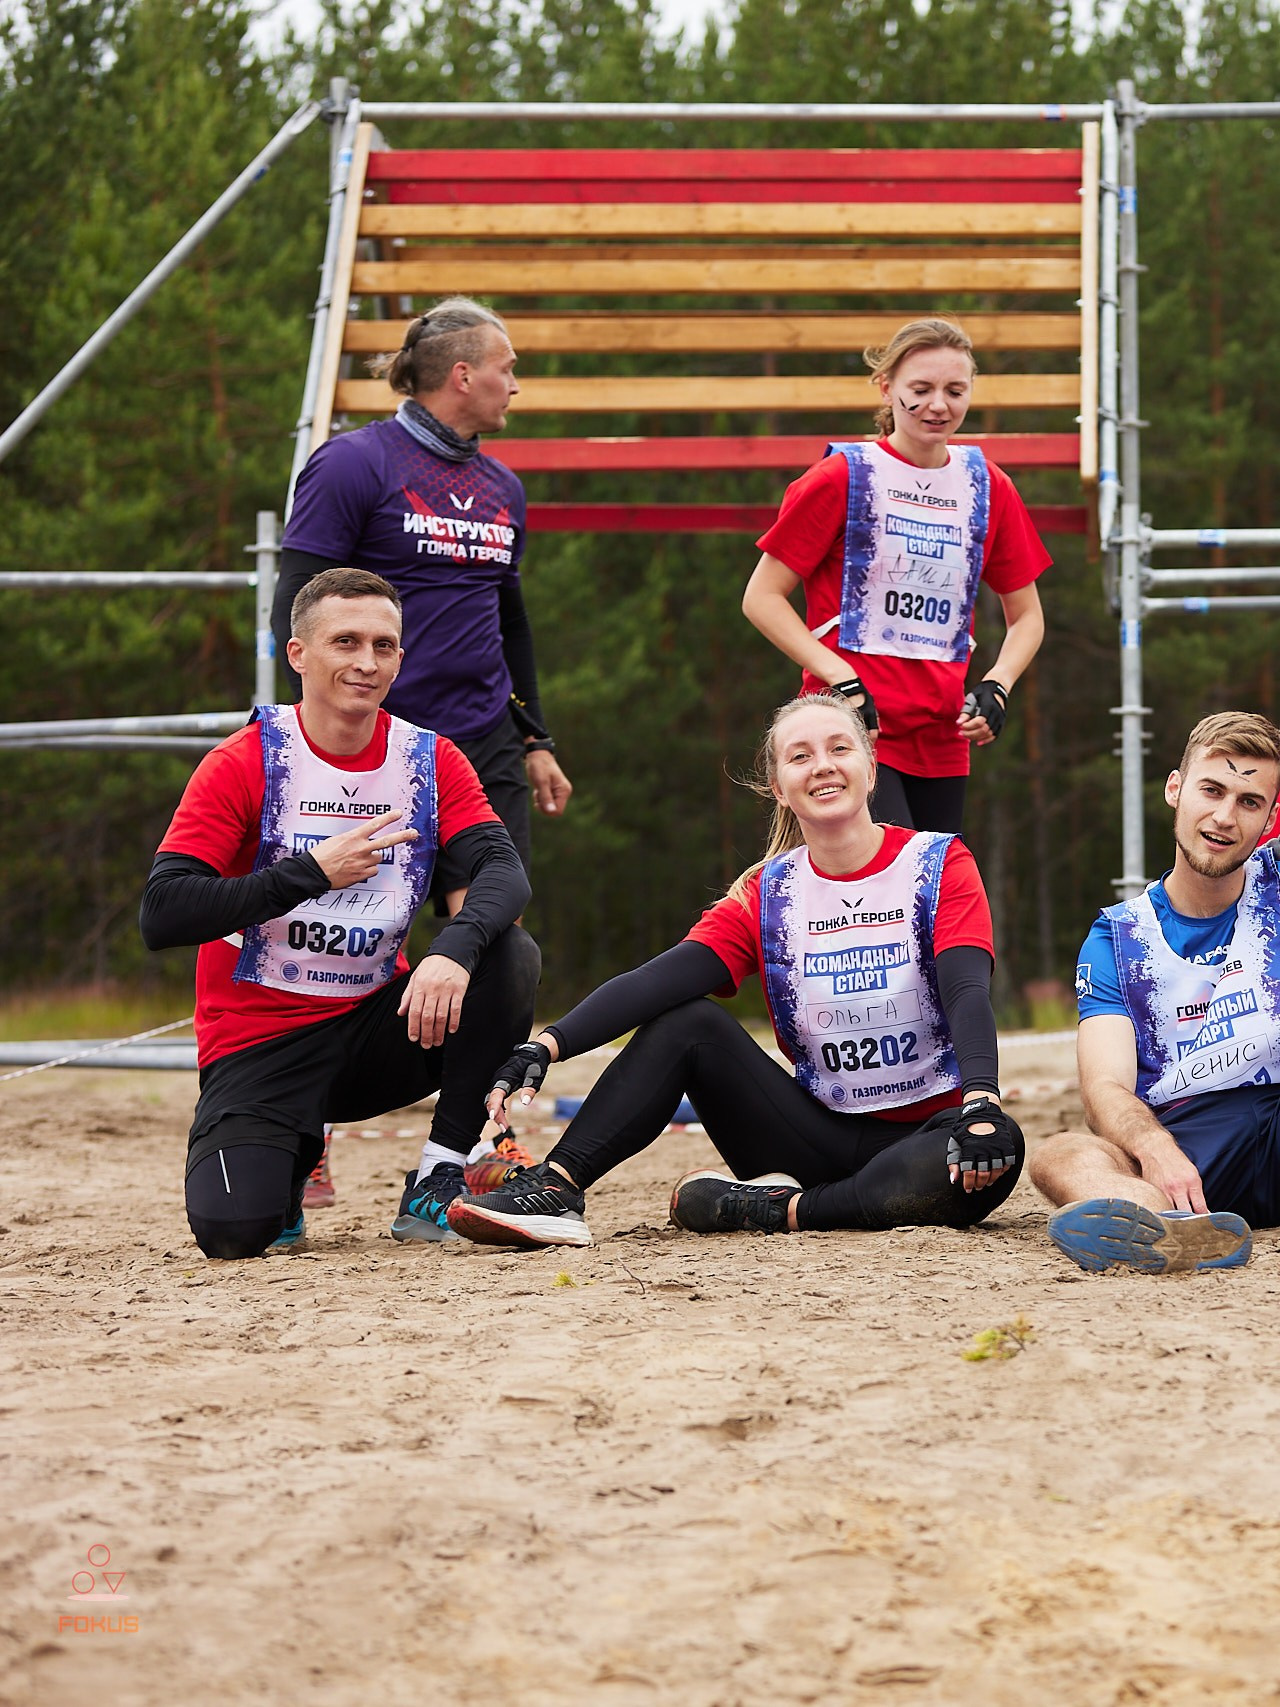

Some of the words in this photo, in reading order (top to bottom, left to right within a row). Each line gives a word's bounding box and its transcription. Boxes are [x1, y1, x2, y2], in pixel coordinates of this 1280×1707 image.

[887, 488, 919, 502] ГОНКА
[922, 495, 958, 508] ГЕРОЕВ
[403, 512, 515, 546] ИНСТРУКТОР
[887, 516, 961, 544] КОМАНДНЫЙ
[417, 539, 467, 558] ГОНКА
[908, 538, 943, 557] СТАРТ
[884, 590, 951, 625] 03209
[900, 632, 948, 648] ГАЗПРОМБАНК
[300, 801, 345, 814] ГОНКА
[808, 914, 848, 932] ГОНКА
[852, 908, 904, 924] ГЕРОЕВ
[288, 920, 385, 958] 03203
[806, 940, 909, 974] КОМАНДНЫЙ
[307, 969, 374, 985] ГАЗПРОМБАНК
[836, 970, 884, 993] СТАРТ
[1176, 1001, 1210, 1018] ГОНК
[820, 1031, 919, 1073] 03202
[852, 1076, 926, 1098] ГАЗПРОМБАНК
